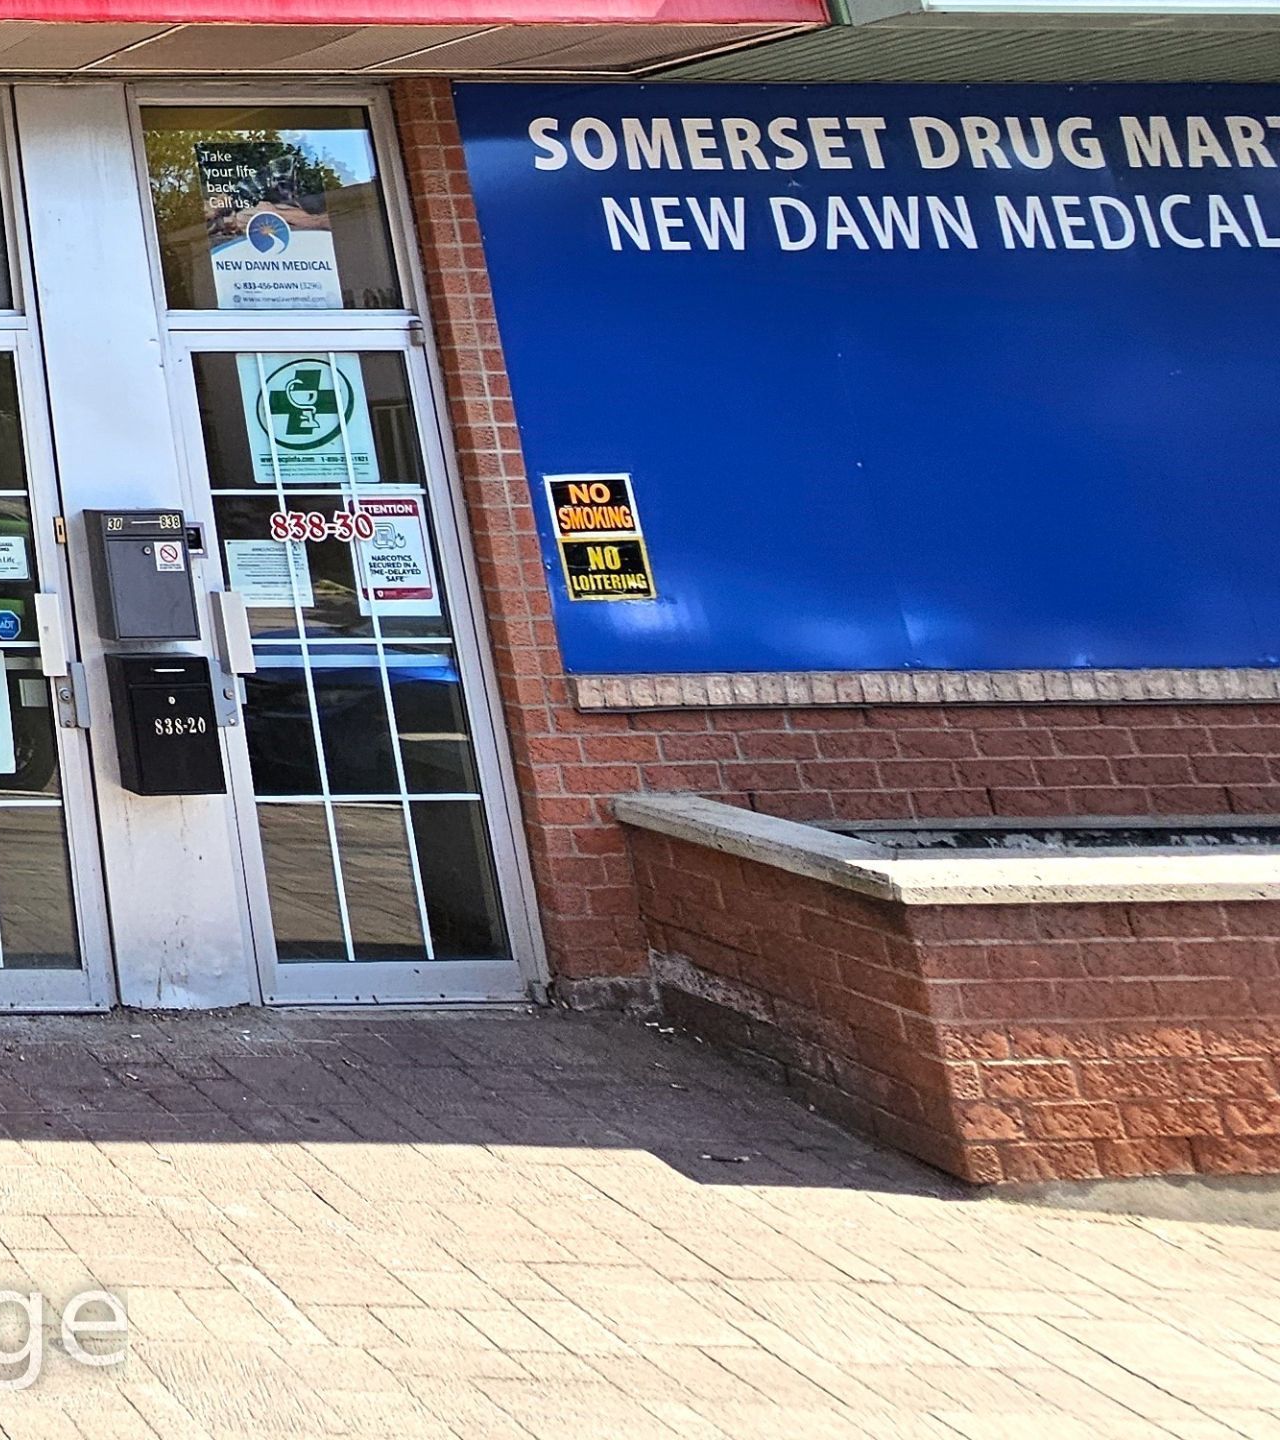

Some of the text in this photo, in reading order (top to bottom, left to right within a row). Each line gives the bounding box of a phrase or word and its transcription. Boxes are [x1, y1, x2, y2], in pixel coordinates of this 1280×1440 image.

[528, 116, 886, 171] SOMERSET
[909, 116, 1105, 169] DRUG
[201, 150, 232, 162] Take
[203, 165, 257, 179] your life
[206, 180, 240, 193] back.
[209, 197, 233, 209] Call
[601, 194, 1280, 252] NEW DAWN MEDICAL
[216, 260, 332, 271] NEW DAWN MEDICAL
[568, 482, 611, 504] NO
[359, 504, 413, 515] TTENTION
[558, 505, 634, 530] SMOKING
[108, 517, 122, 530] 30
[161, 516, 180, 528] 838
[271, 512, 375, 541] 838-30
[587, 545, 622, 571] NO
[571, 573, 648, 591] LOITERING
[154, 716, 206, 735] 838-20
